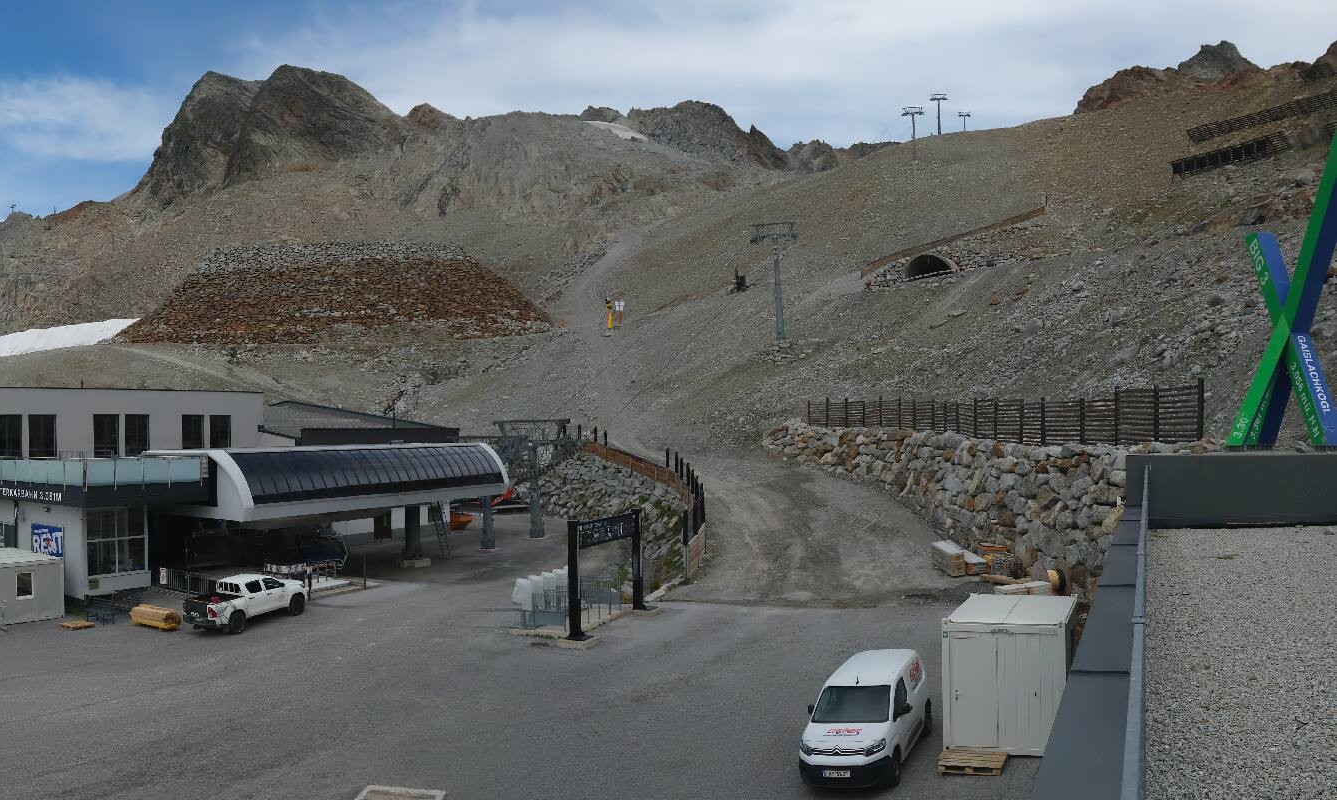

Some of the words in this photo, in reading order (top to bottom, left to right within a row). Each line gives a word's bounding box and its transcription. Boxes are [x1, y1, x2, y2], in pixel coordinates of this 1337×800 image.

[1249, 238, 1265, 273] BIG
[1260, 277, 1269, 287] 3
[1297, 335, 1331, 415] GAISLACHKOGL
